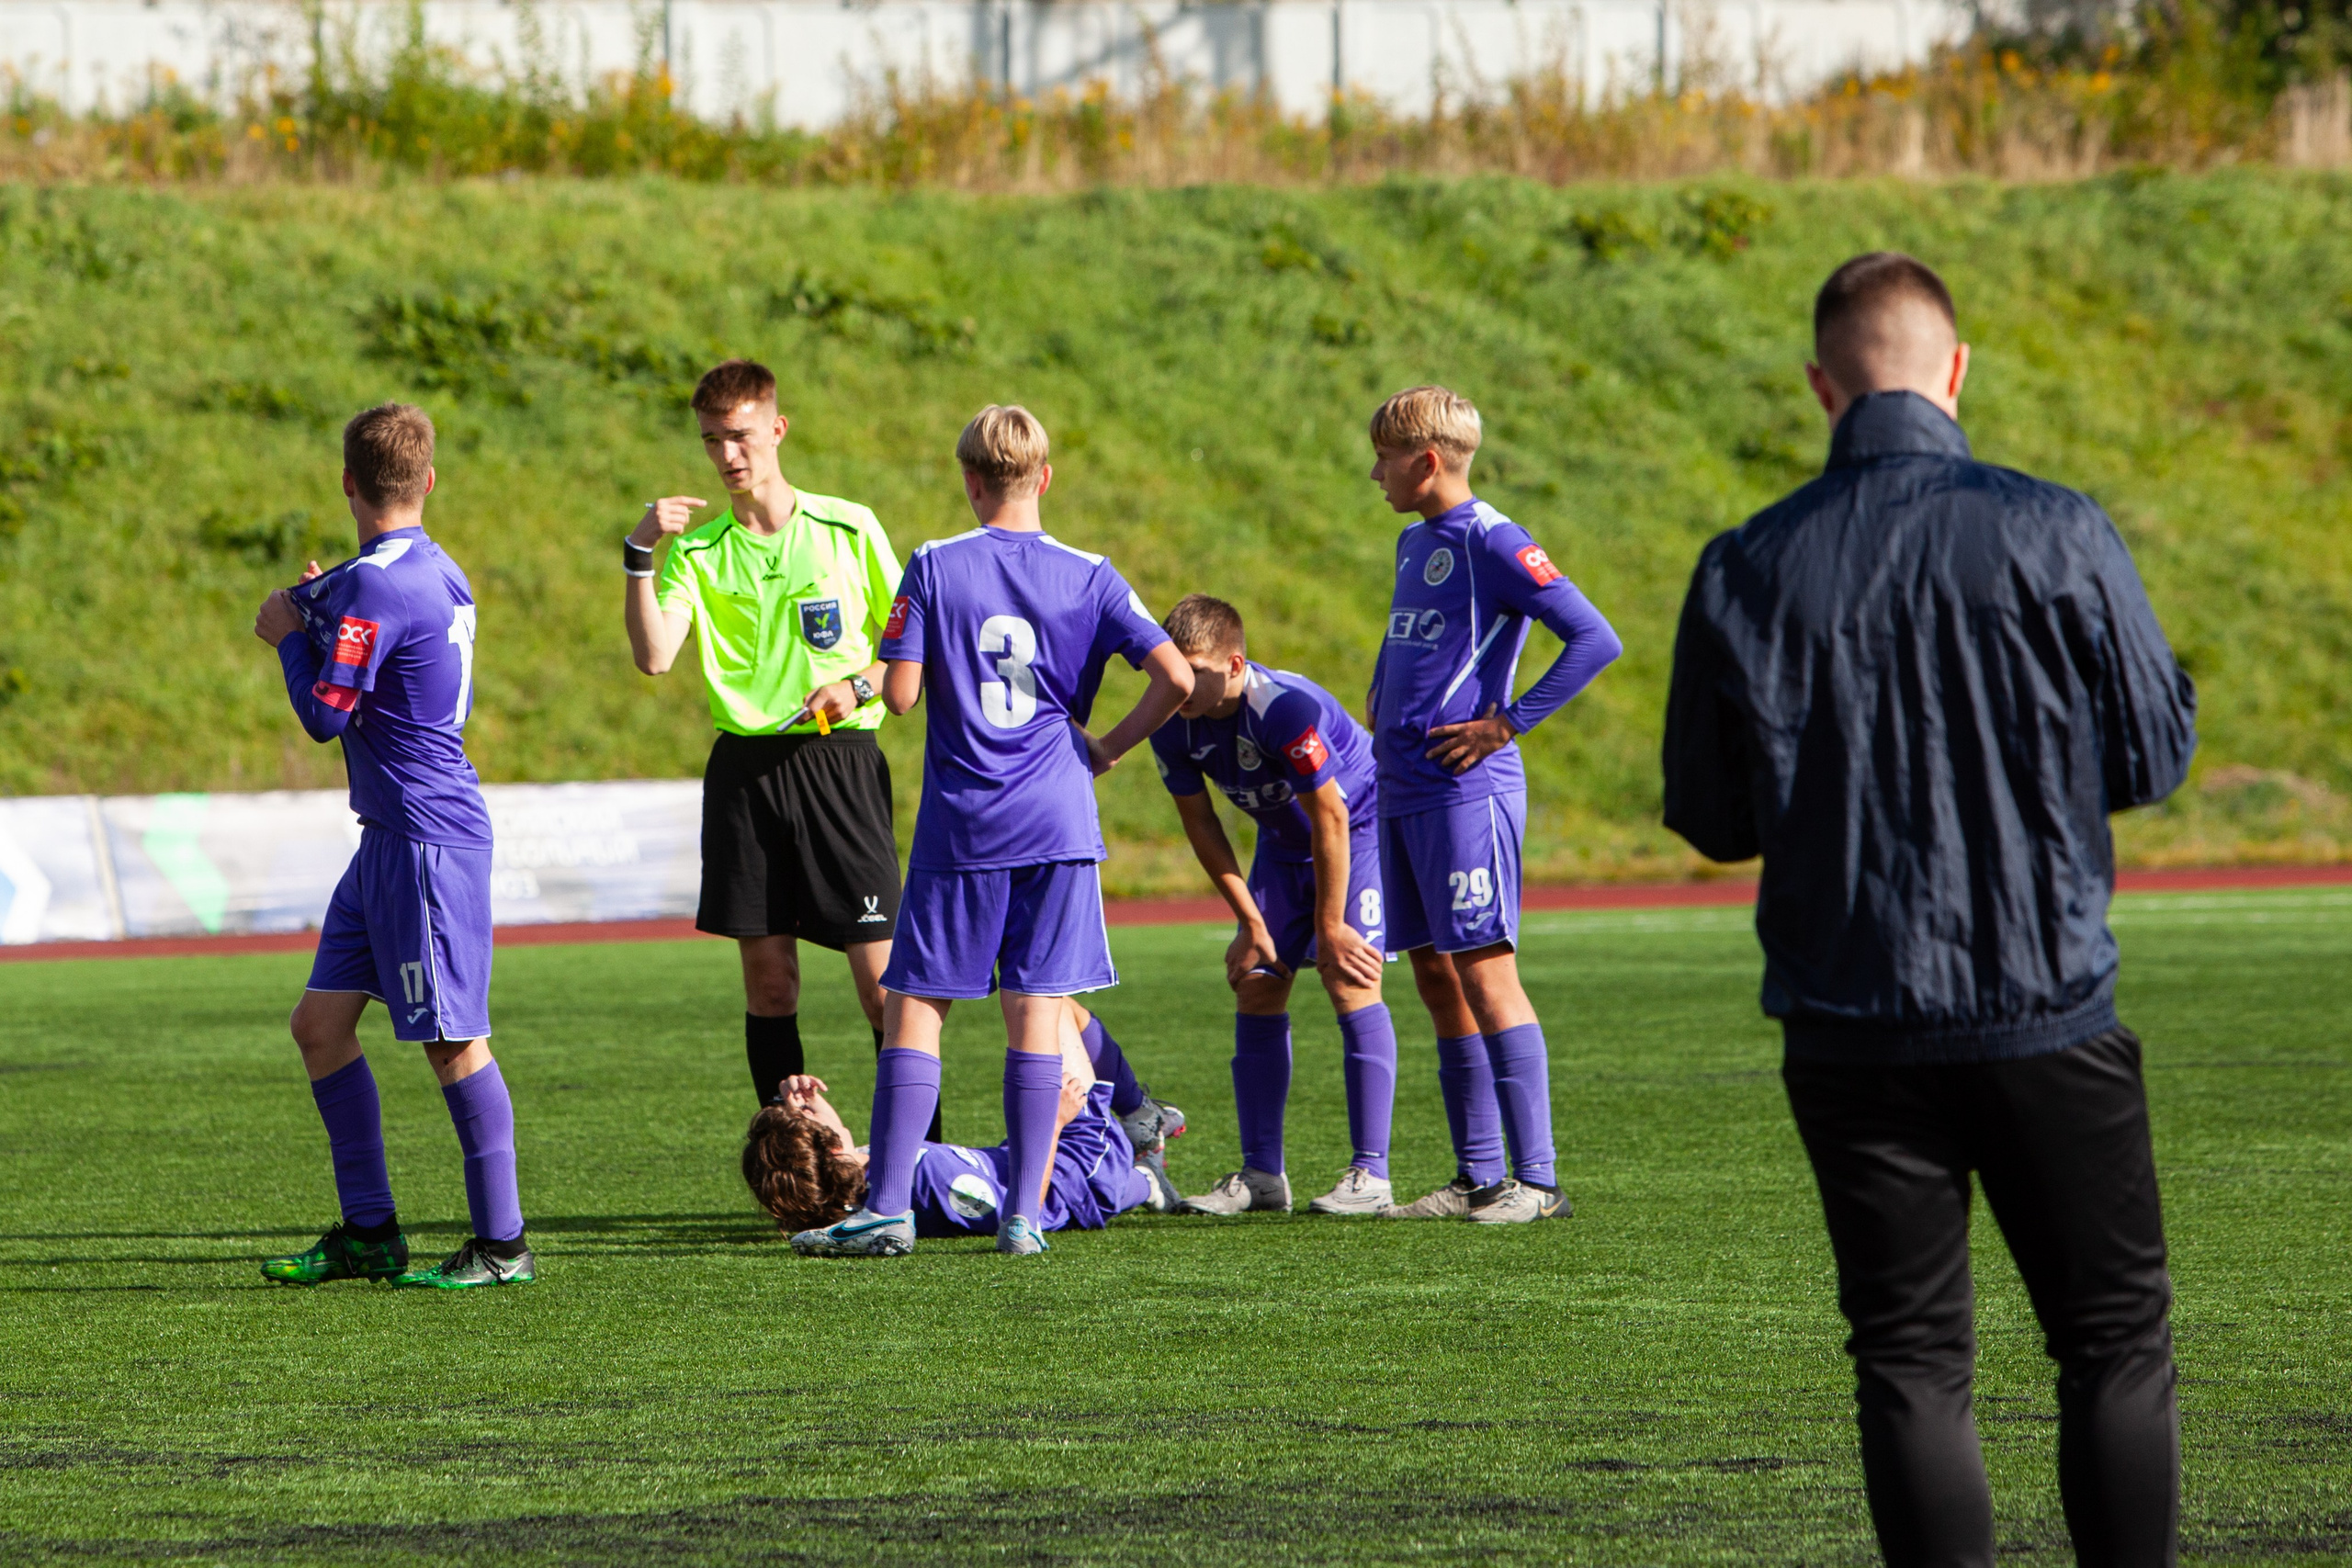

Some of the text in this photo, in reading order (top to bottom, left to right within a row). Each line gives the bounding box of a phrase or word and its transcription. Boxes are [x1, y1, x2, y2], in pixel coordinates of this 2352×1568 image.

[804, 602, 837, 613] РОССИЯ
[978, 615, 1037, 728] 3
[1360, 888, 1381, 926] 8
[1449, 867, 1493, 910] 29
[400, 961, 424, 1004] 17
